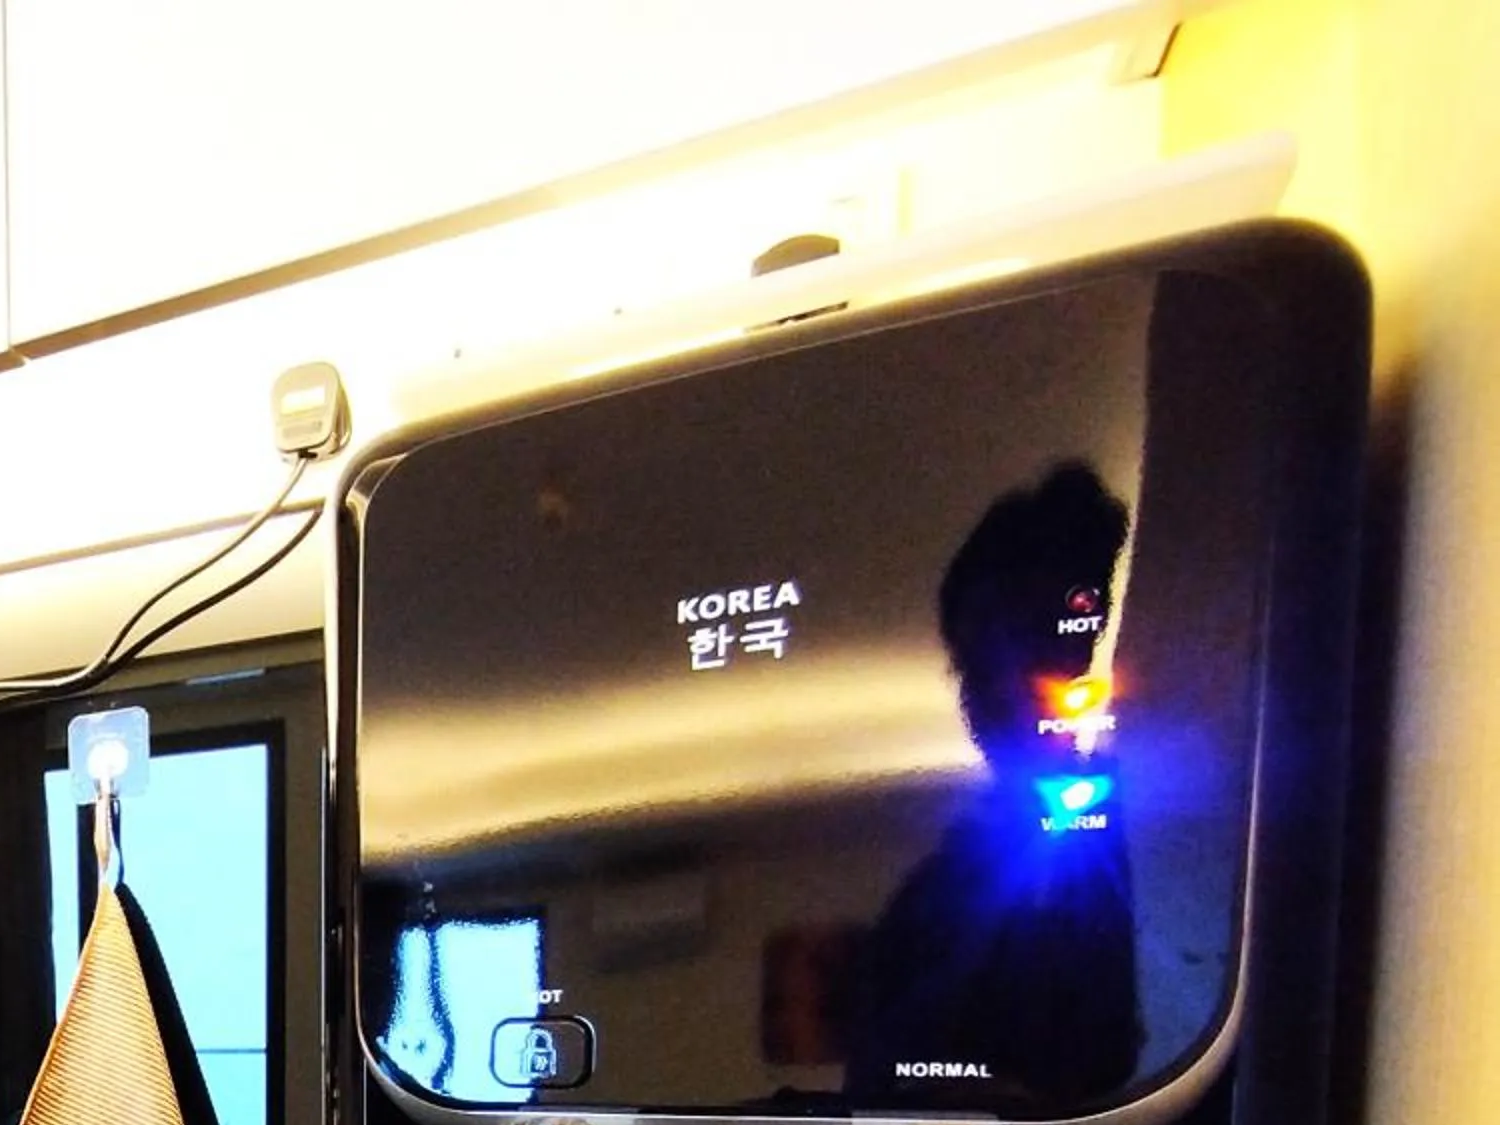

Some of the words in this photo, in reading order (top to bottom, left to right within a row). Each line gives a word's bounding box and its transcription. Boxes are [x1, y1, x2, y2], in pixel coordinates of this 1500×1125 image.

[677, 581, 800, 624] KOREA
[1057, 615, 1103, 635] HOT
[687, 618, 789, 670] 한국
[1037, 715, 1116, 735] POR
[527, 989, 563, 1004] OT
[895, 1062, 993, 1078] NORMAL
